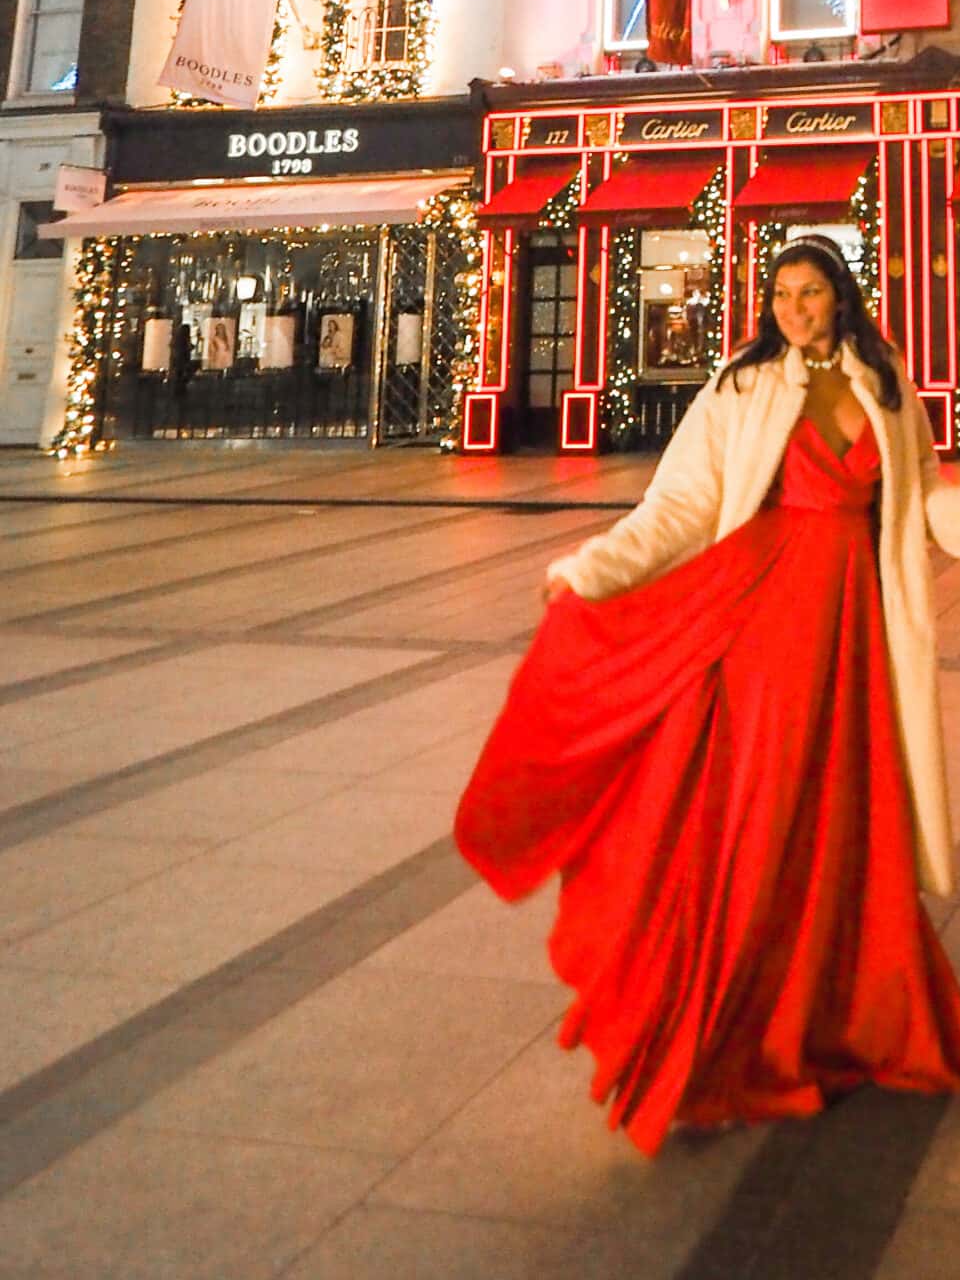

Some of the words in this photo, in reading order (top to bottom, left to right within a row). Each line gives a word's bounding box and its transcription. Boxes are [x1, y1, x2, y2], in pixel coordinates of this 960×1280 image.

[175, 55, 255, 87] BOODLES
[641, 118, 710, 140] Cartier
[786, 111, 857, 133] Cartier
[227, 128, 359, 158] BOODLES
[271, 158, 313, 175] 1798
